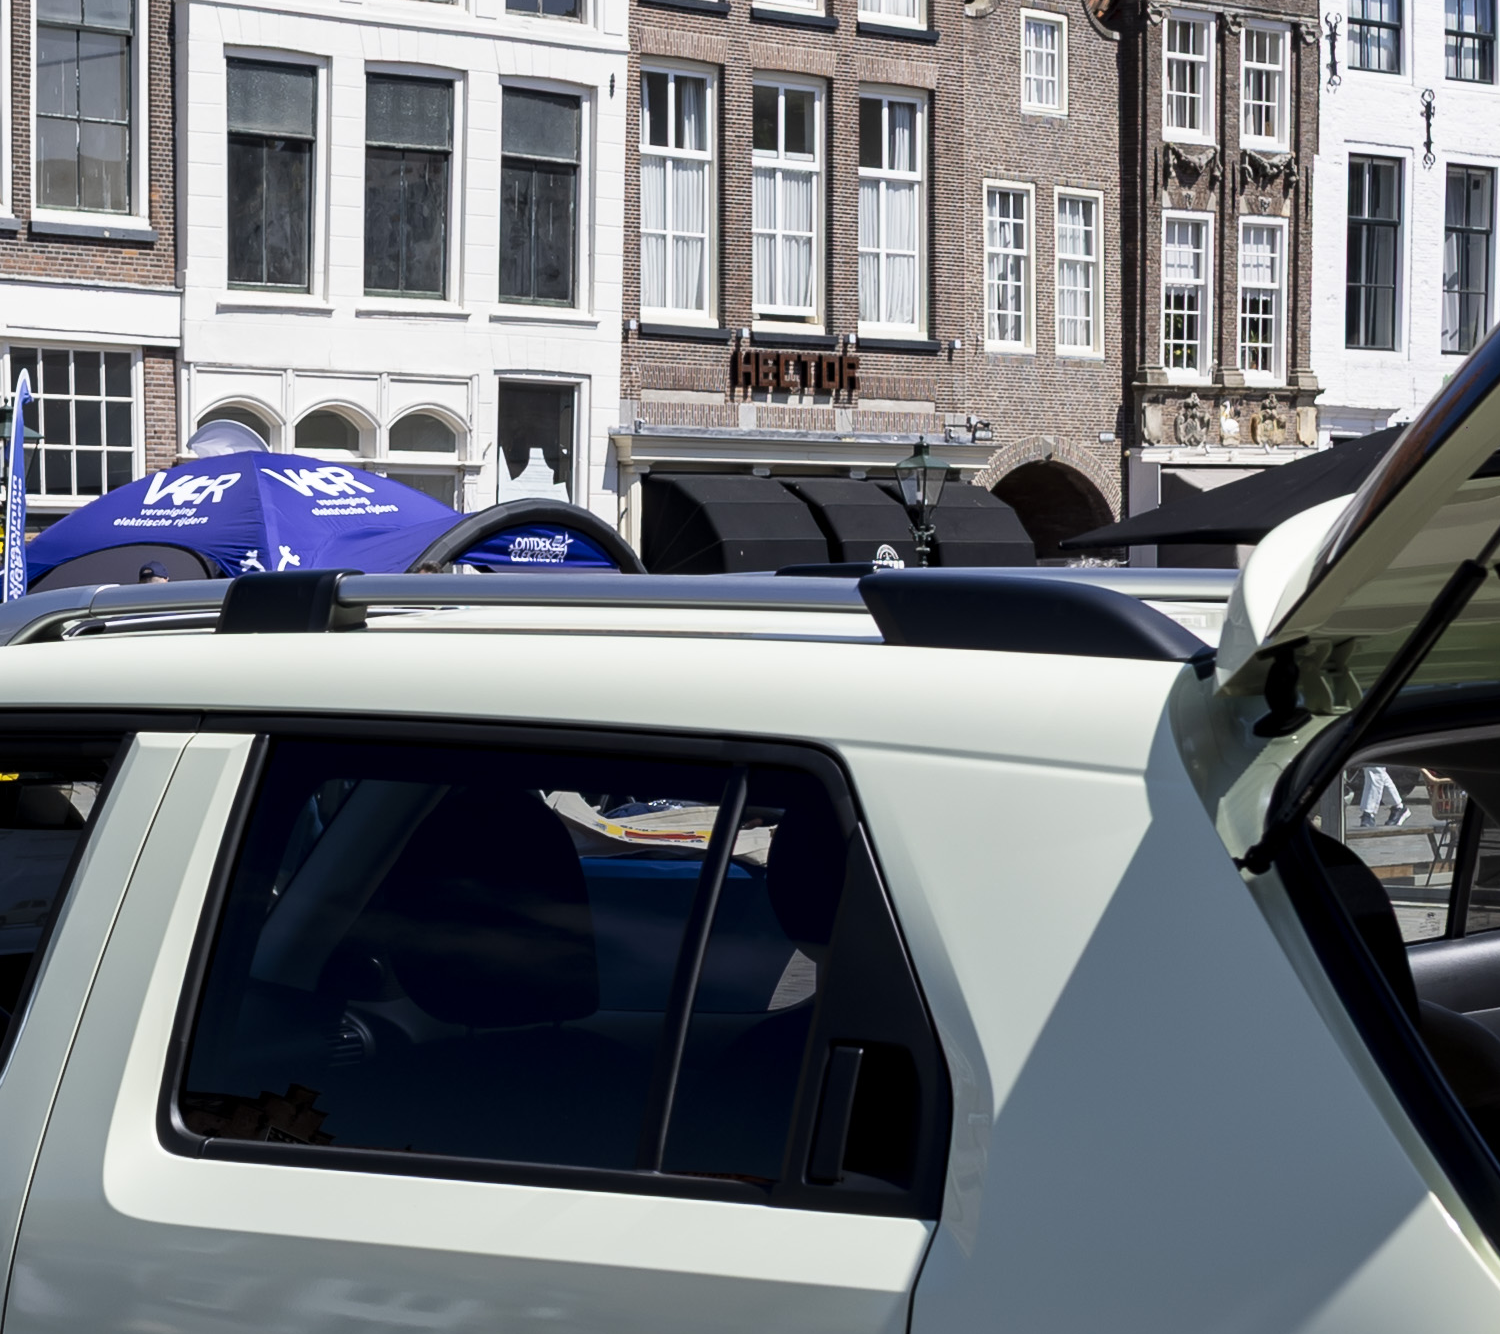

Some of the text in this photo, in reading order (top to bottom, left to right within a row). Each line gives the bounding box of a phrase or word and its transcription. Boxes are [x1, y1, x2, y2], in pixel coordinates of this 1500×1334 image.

[737, 351, 861, 391] HECTOR
[140, 507, 198, 518] vereniging
[113, 516, 209, 528] elektrische rijders
[515, 537, 553, 551] ONTDEK
